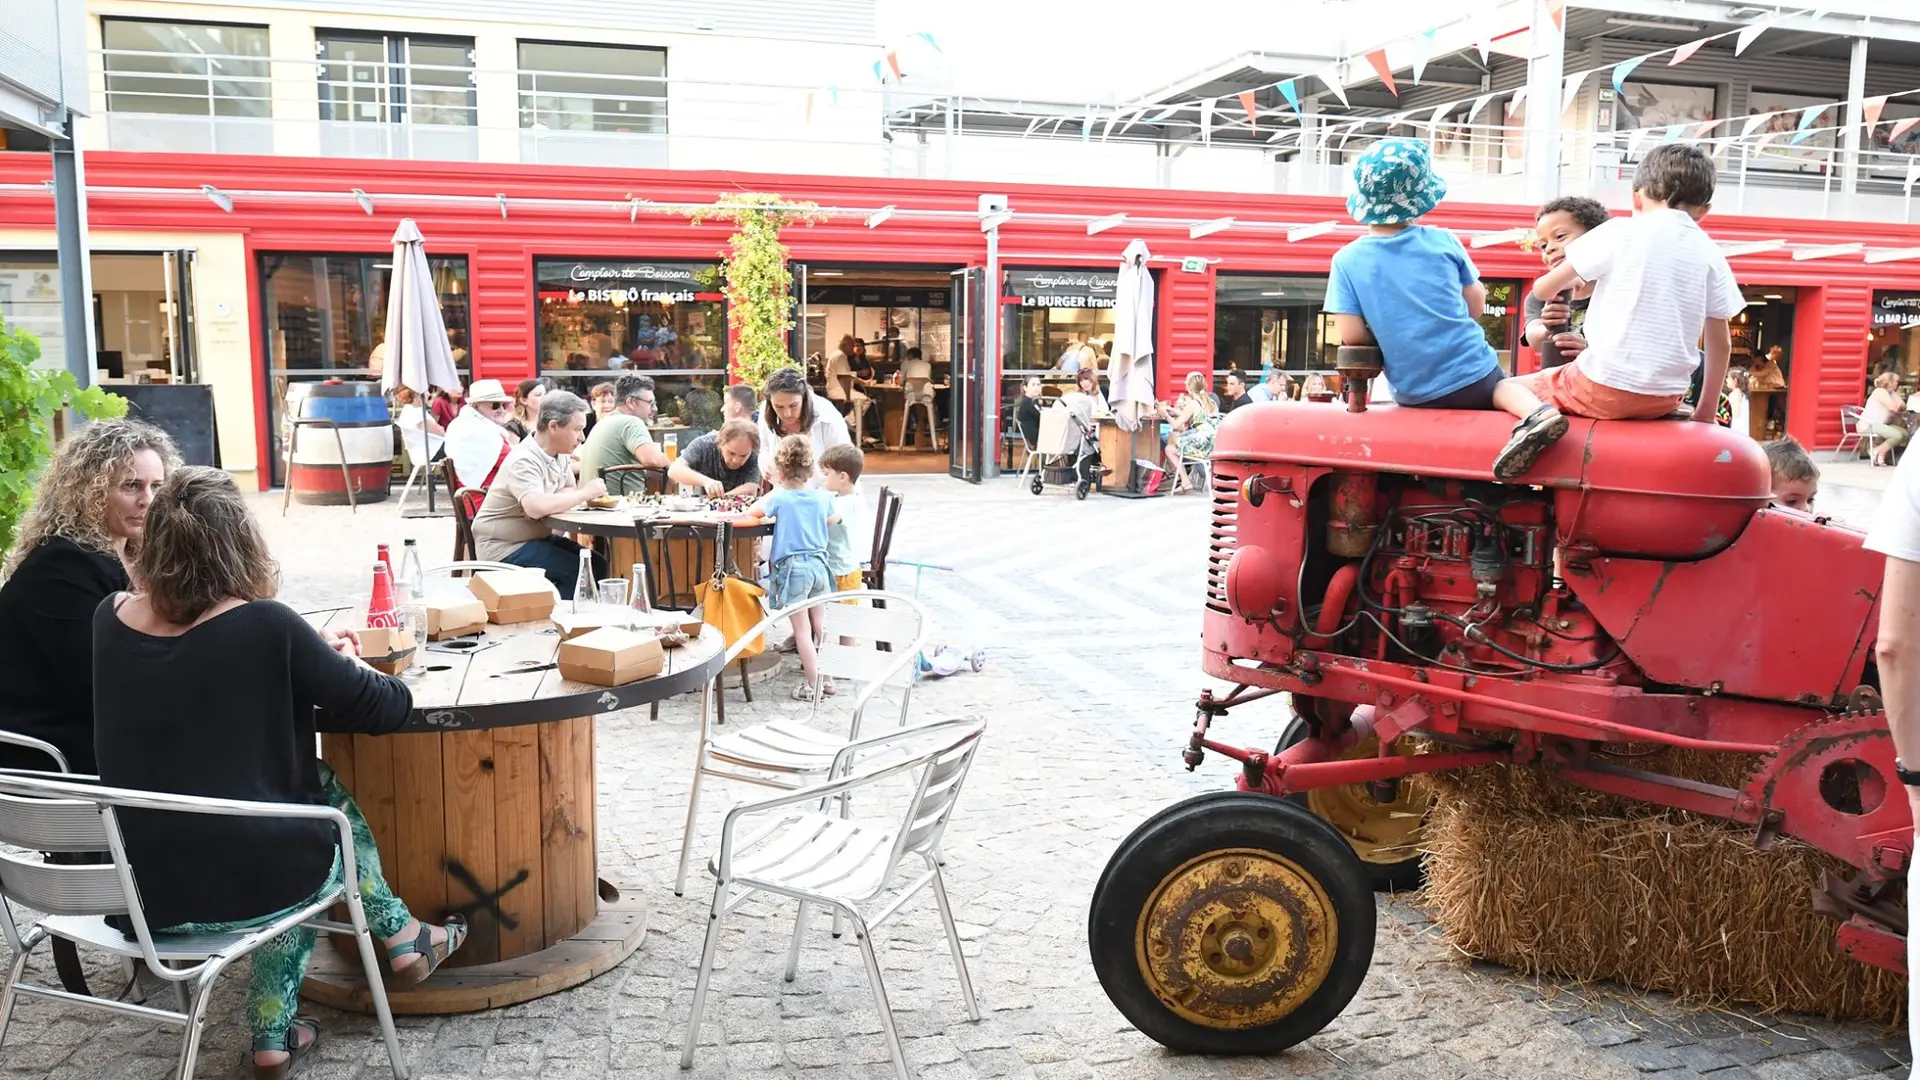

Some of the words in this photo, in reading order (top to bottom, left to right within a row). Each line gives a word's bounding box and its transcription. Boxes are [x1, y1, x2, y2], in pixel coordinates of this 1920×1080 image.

[570, 265, 620, 281] Comptoir
[641, 266, 690, 279] Boissons
[1025, 273, 1075, 289] Comptoir
[1088, 275, 1118, 291] Cuisin
[569, 289, 585, 302] Le
[588, 287, 639, 302] BISTRÔ
[641, 288, 694, 304] français
[1021, 295, 1036, 307] Le
[1037, 295, 1086, 308] BURGER
[1087, 296, 1118, 309] franç
[1874, 313, 1884, 323] Le
[1885, 313, 1901, 324] BAR
[1902, 312, 1908, 324] à
